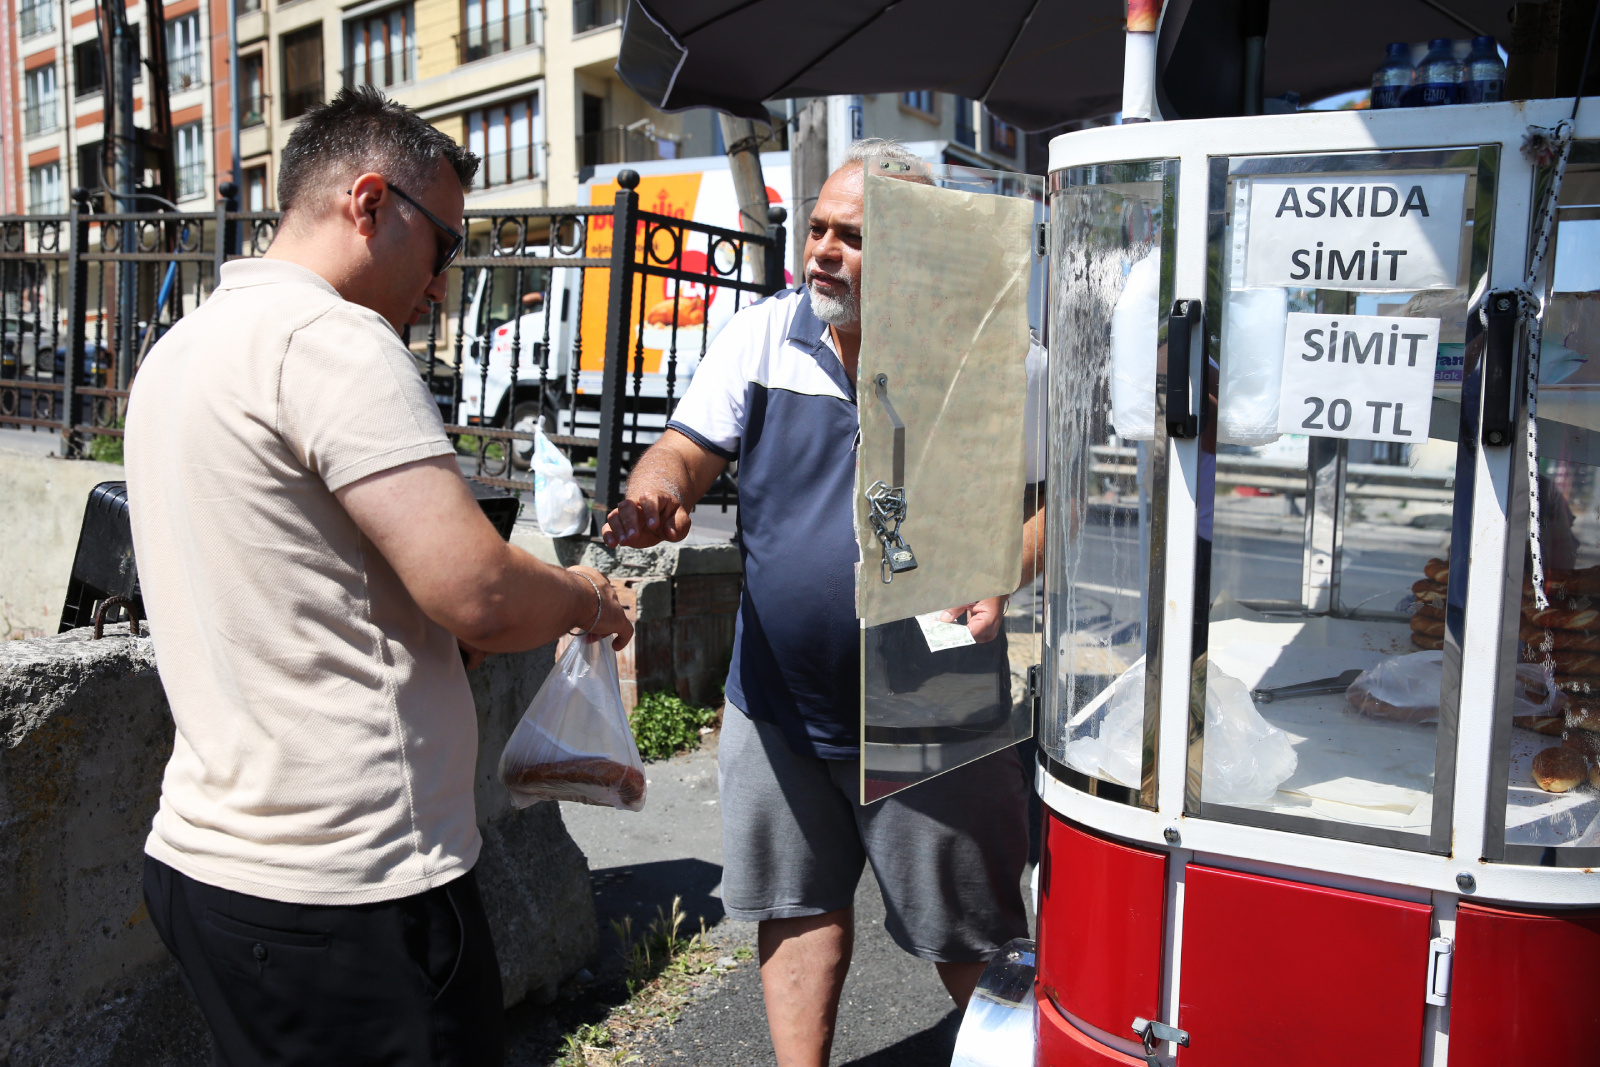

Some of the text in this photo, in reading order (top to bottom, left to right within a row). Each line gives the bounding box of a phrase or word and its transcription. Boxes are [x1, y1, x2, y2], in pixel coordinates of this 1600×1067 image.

[1275, 185, 1430, 218] ASKIDA
[1290, 241, 1408, 281] SİMİT
[1301, 321, 1429, 367] SİMİT
[1301, 396, 1413, 437] 20 TL
